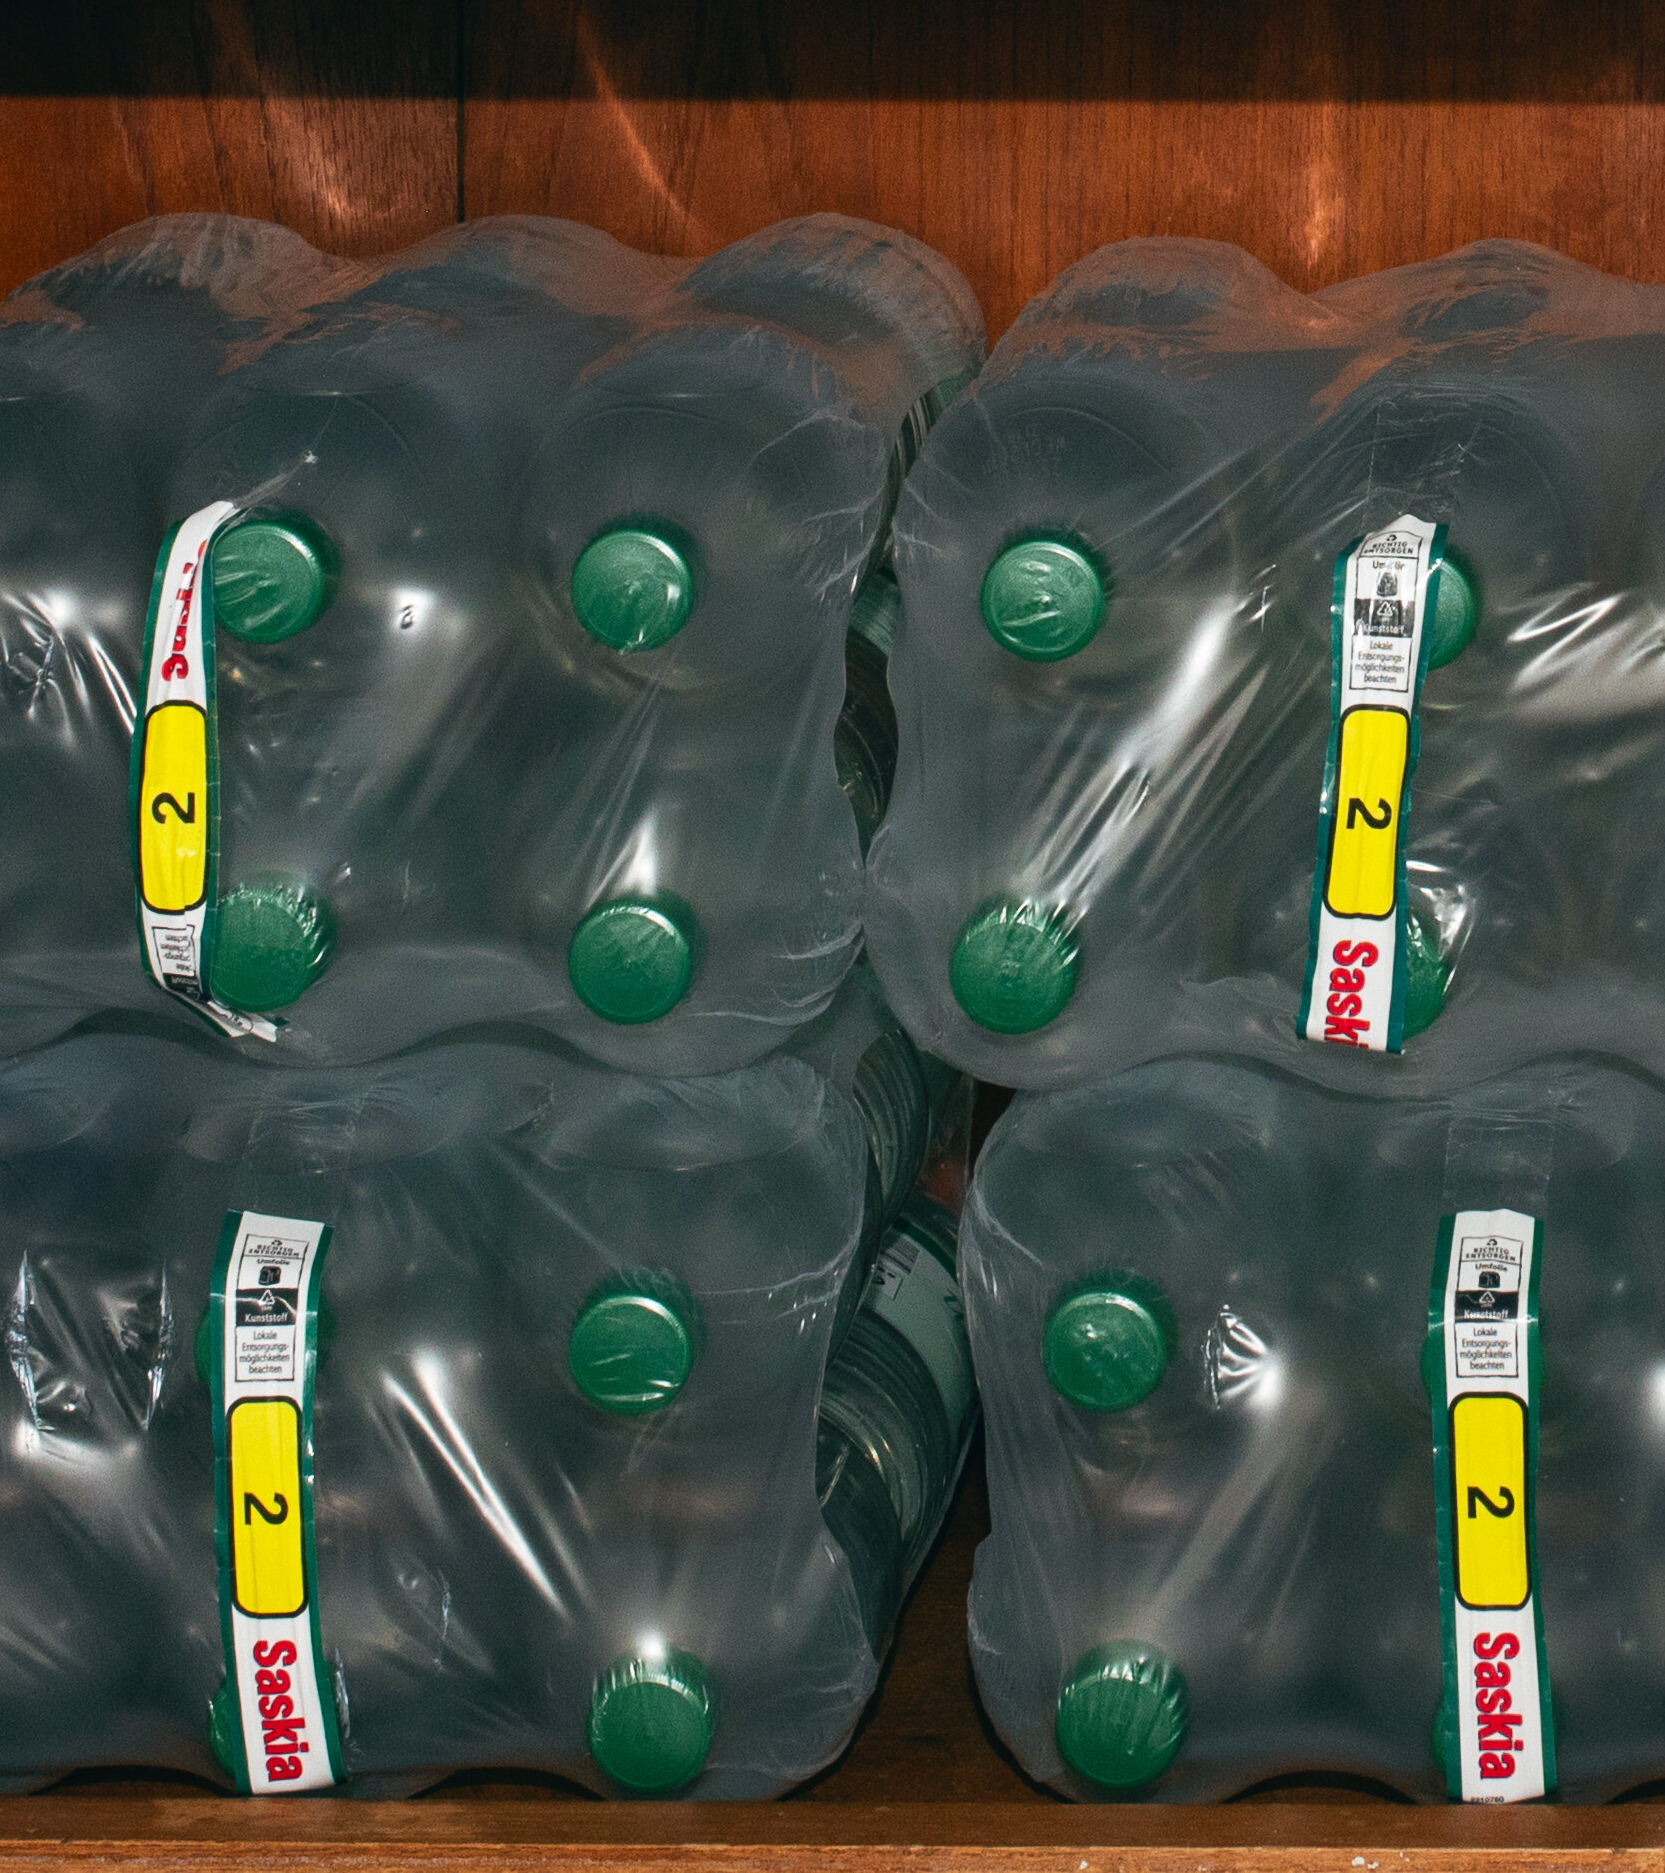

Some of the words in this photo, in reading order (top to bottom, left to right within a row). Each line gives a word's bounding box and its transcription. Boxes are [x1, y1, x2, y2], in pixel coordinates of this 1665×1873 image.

[152, 791, 195, 825] 2
[1346, 797, 1393, 830] 2
[244, 1312, 289, 1324] Kunststoff
[253, 1330, 278, 1341] Lokale
[1473, 1327, 1498, 1337] Lokale
[1461, 1338, 1512, 1349] Entsorgungs-
[239, 1353, 290, 1364] möglichkeiten
[1459, 1349, 1513, 1360] möglichkeiten
[248, 1363, 283, 1374] beachten
[1470, 1360, 1505, 1371] beachten
[1466, 1486, 1516, 1518] 2
[244, 1492, 289, 1526] 2
[253, 1639, 310, 1784] Saskia
[1473, 1631, 1524, 1781] Saskia
